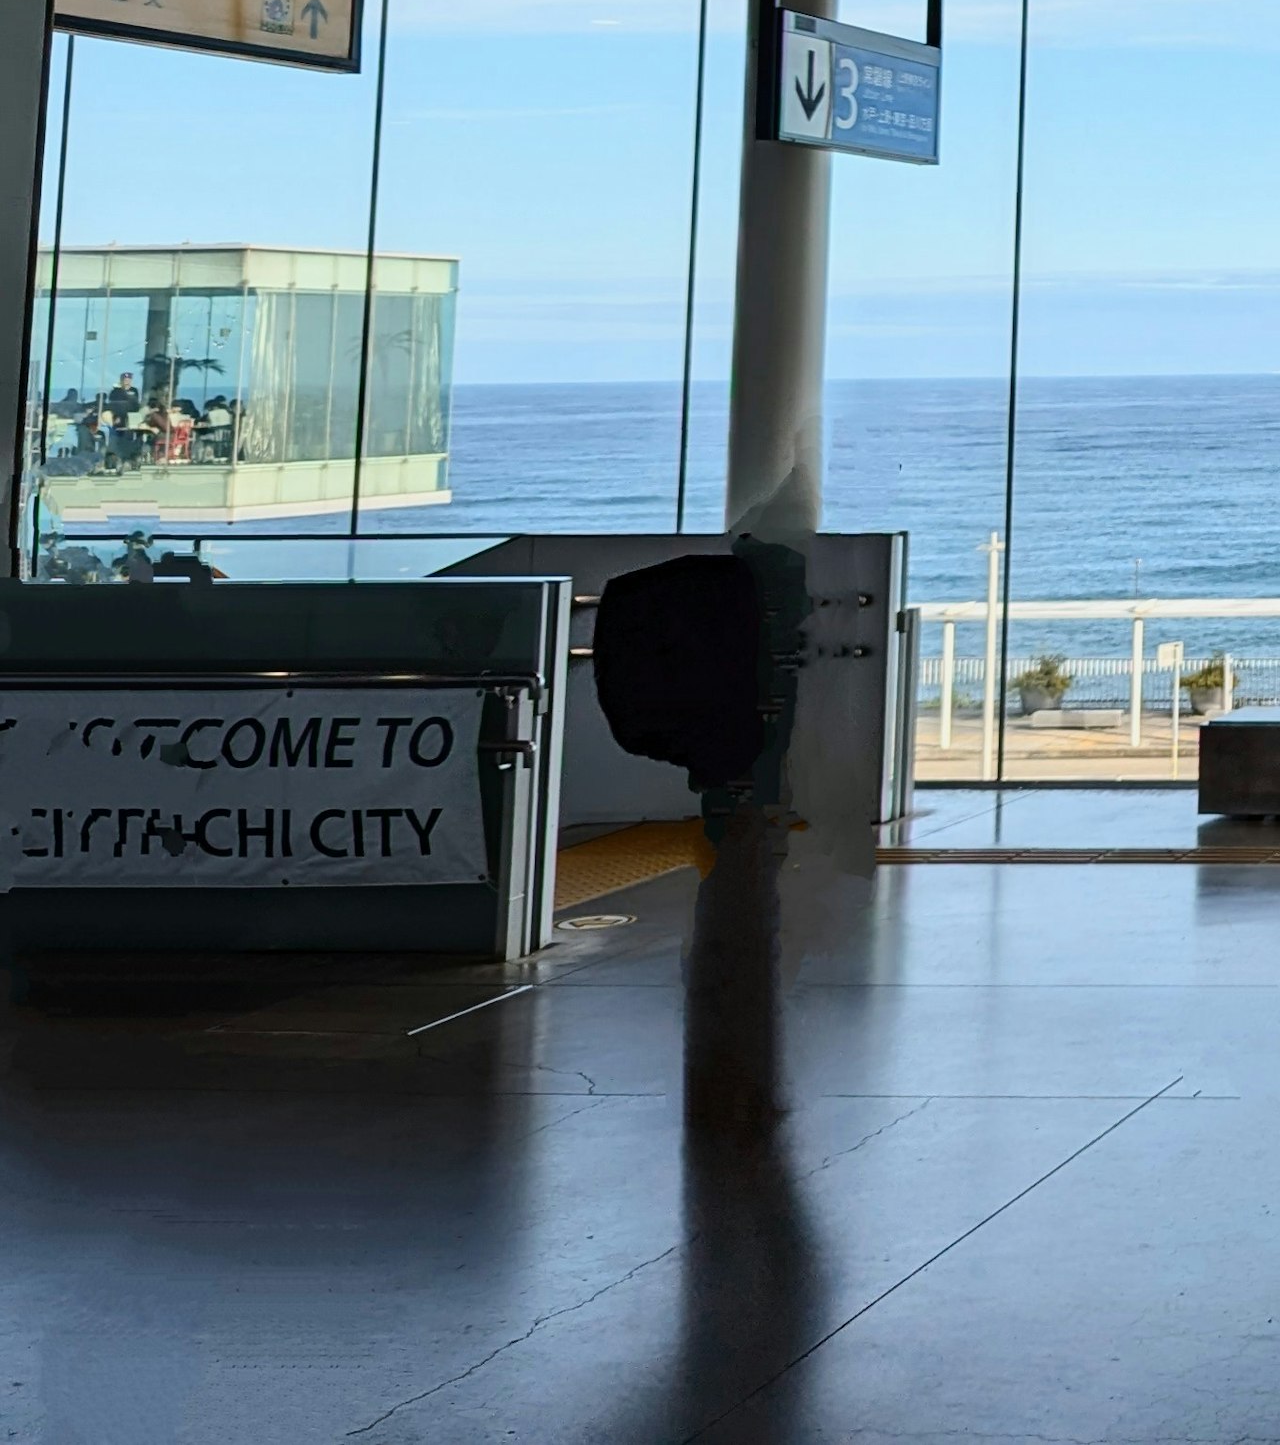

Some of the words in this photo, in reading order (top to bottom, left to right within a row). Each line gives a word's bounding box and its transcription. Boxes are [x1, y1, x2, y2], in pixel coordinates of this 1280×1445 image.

[835, 58, 859, 130] 3
[375, 716, 454, 768] TO
[310, 808, 443, 857] CITY
